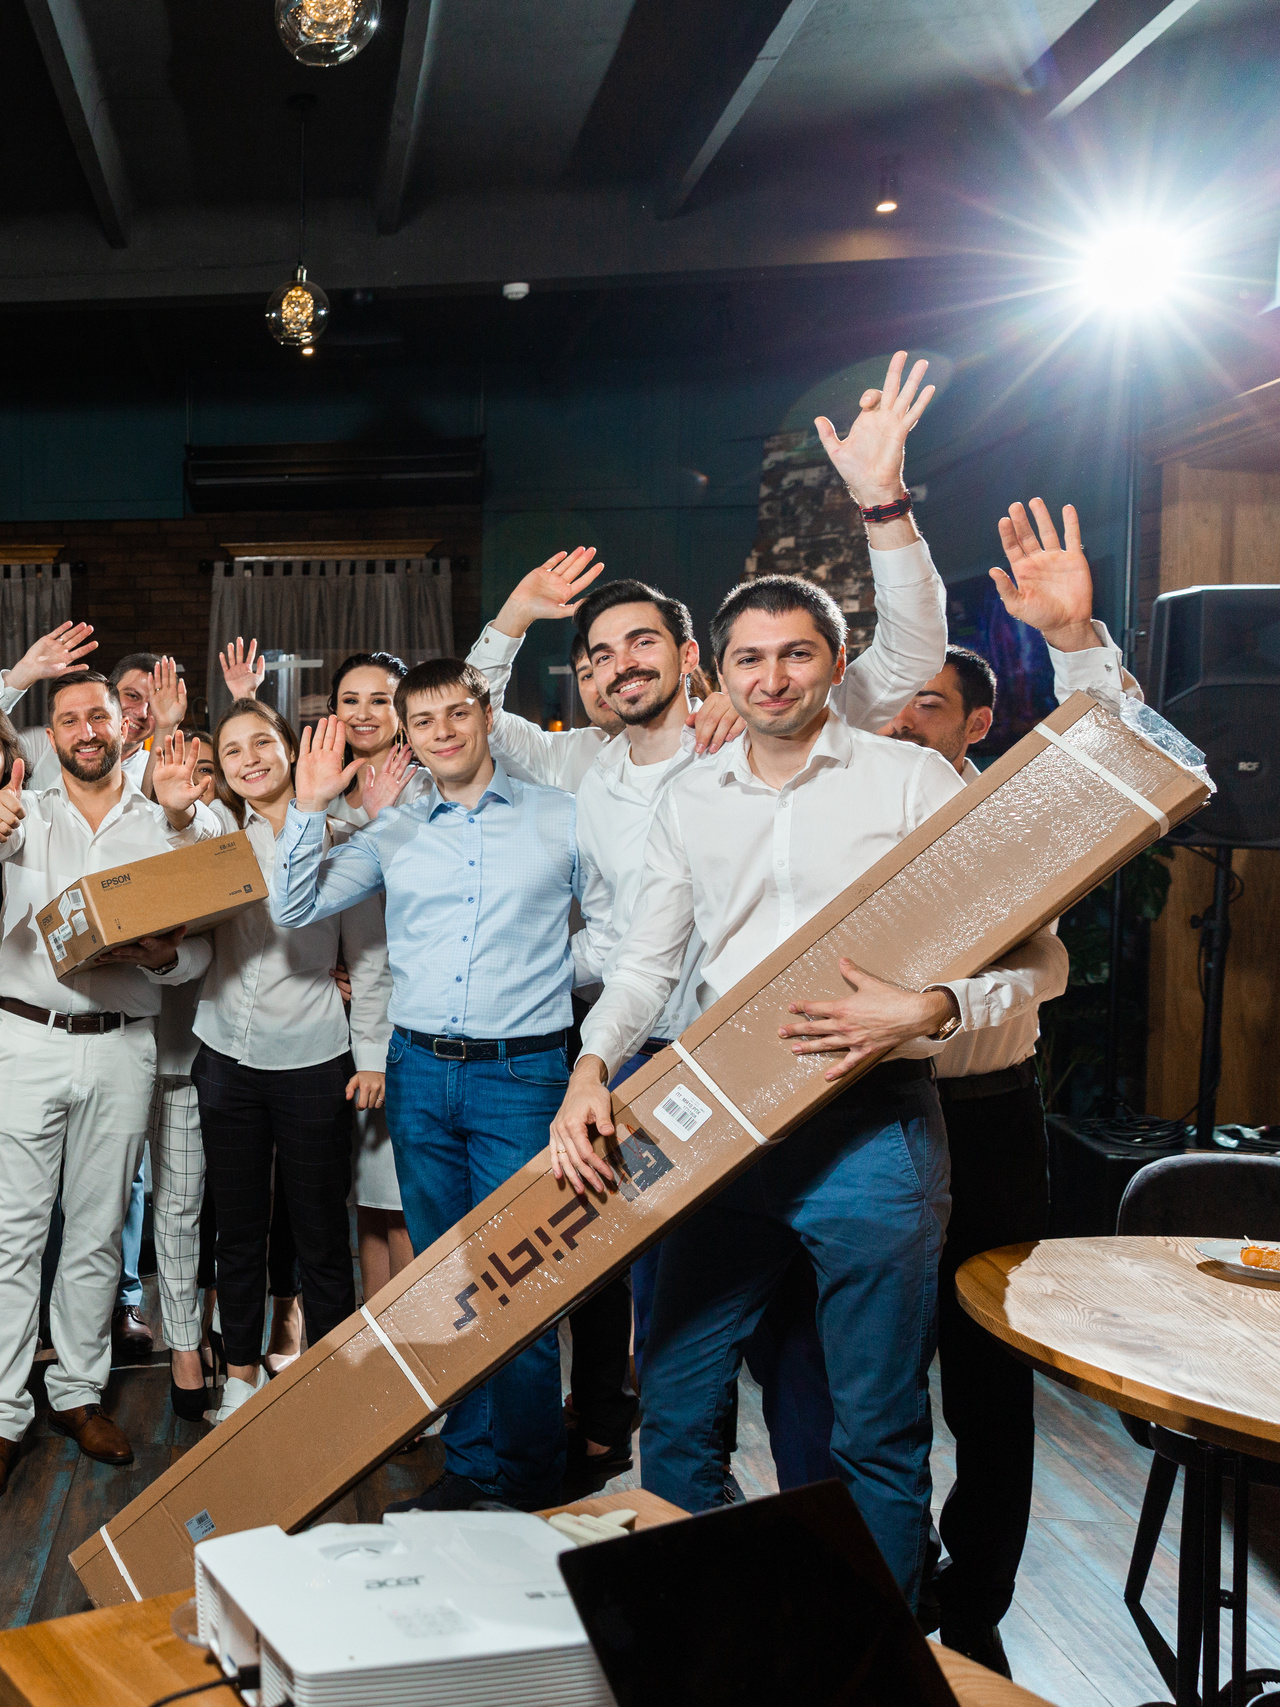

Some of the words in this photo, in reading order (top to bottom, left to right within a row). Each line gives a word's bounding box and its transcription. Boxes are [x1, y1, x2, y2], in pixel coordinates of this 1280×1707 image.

[1238, 761, 1259, 771] RCF
[101, 873, 131, 889] EPSON
[453, 1195, 600, 1332] digis
[365, 1575, 425, 1589] acer
